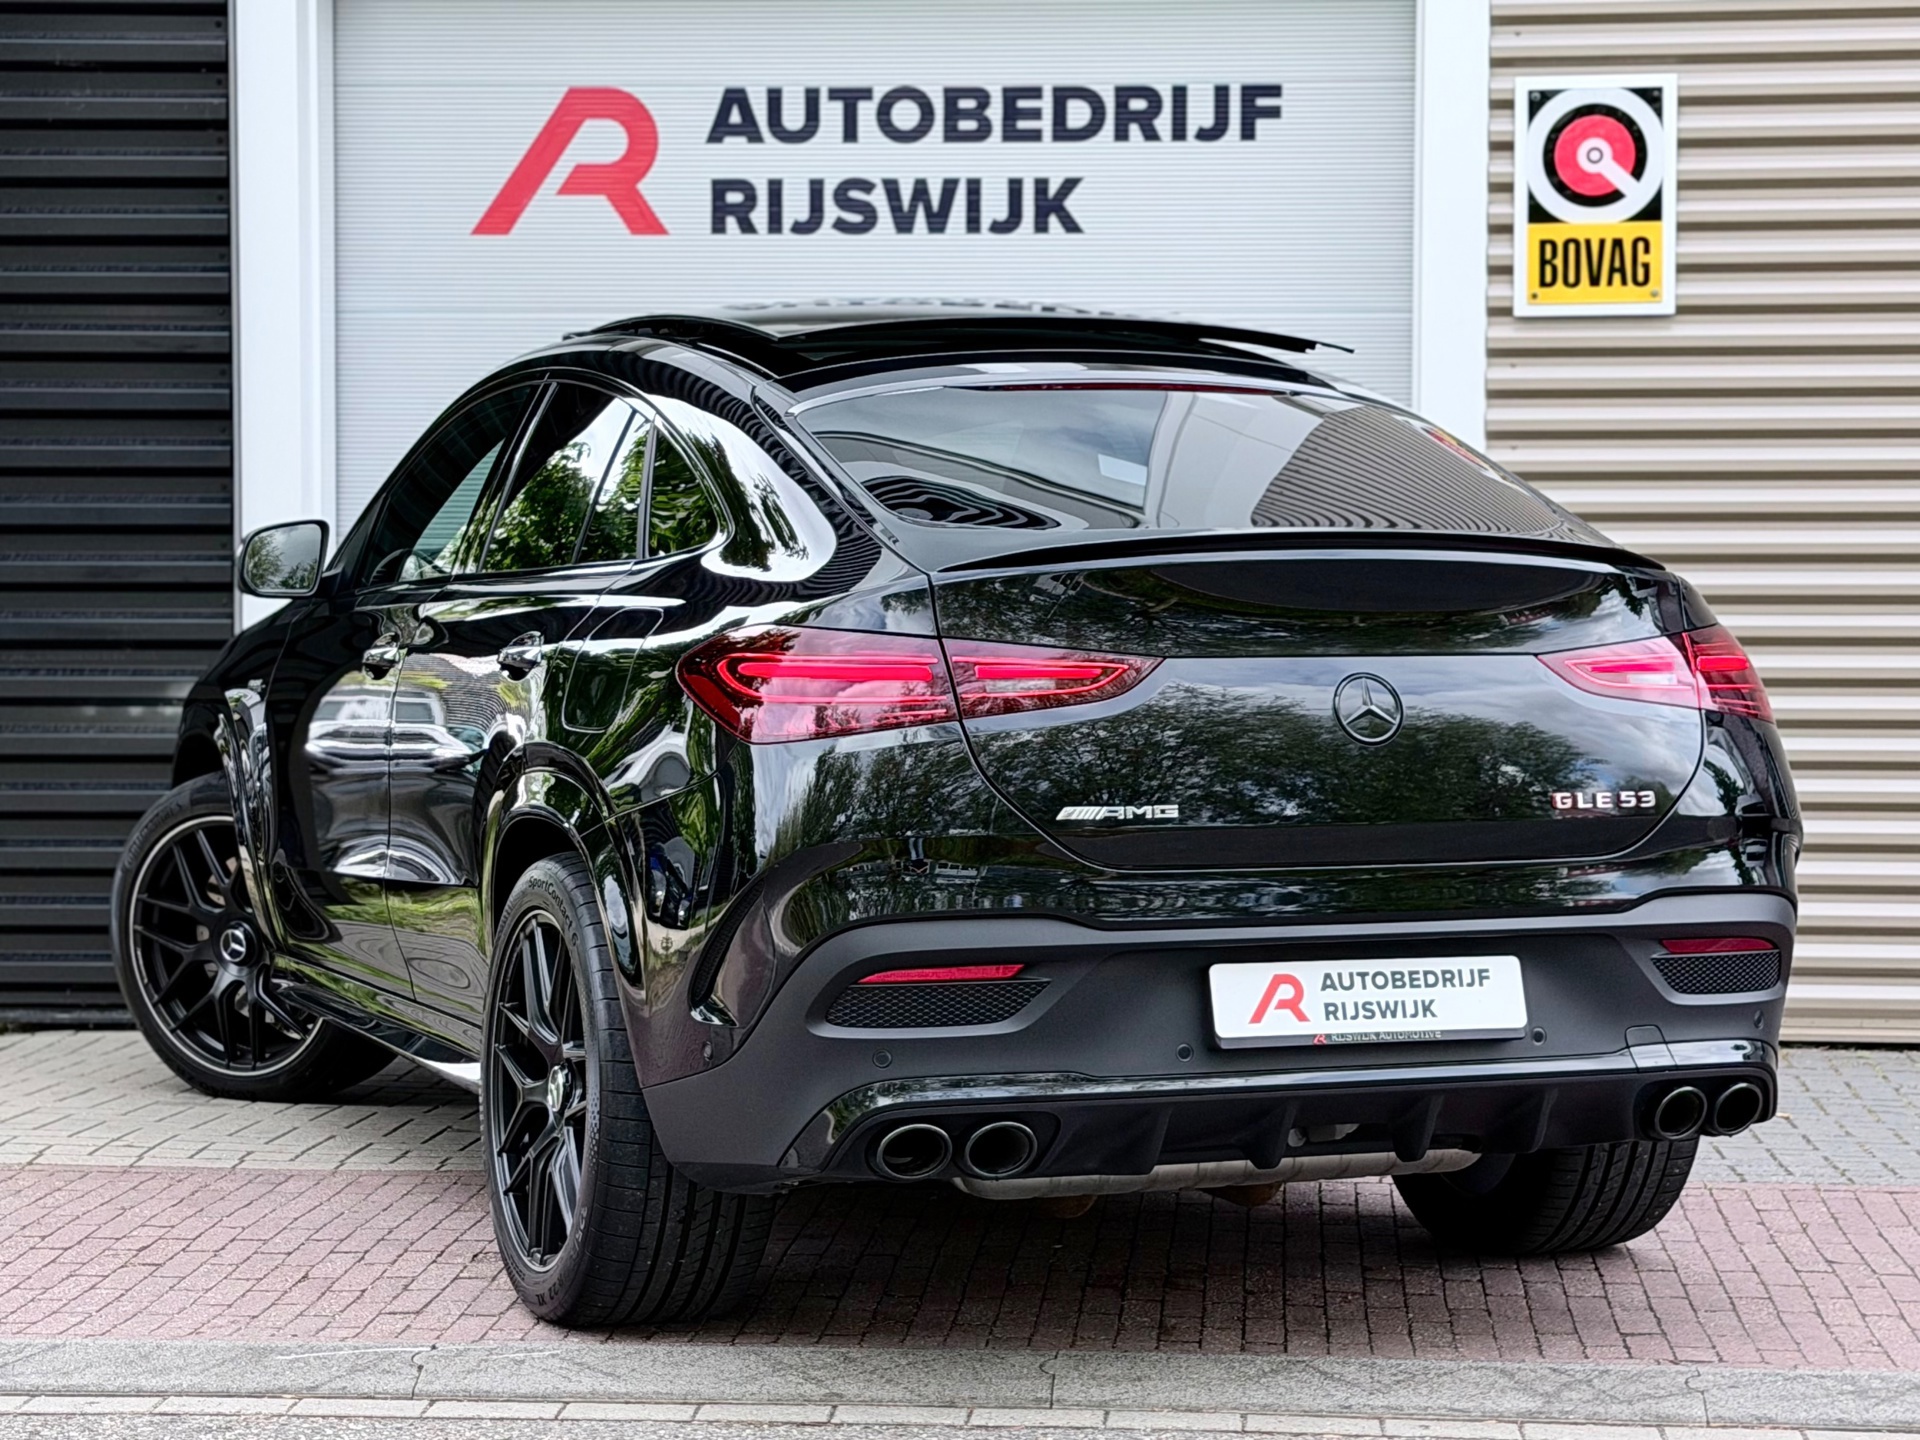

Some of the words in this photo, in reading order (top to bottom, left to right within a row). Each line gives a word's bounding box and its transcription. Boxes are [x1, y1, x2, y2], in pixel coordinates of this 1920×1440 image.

[706, 85, 1283, 144] AUTOBEDRIJF
[710, 178, 1085, 236] RIJSWIJK
[1538, 236, 1651, 289] BOVAG
[1096, 804, 1179, 820] AMG
[1551, 791, 1614, 809] GLE
[1617, 790, 1656, 808] 53
[529, 876, 573, 931] SportContact
[571, 932, 579, 947] 6
[1320, 968, 1491, 992] AUTOBEDRIJF
[1324, 999, 1438, 1022] RIJSWIJK
